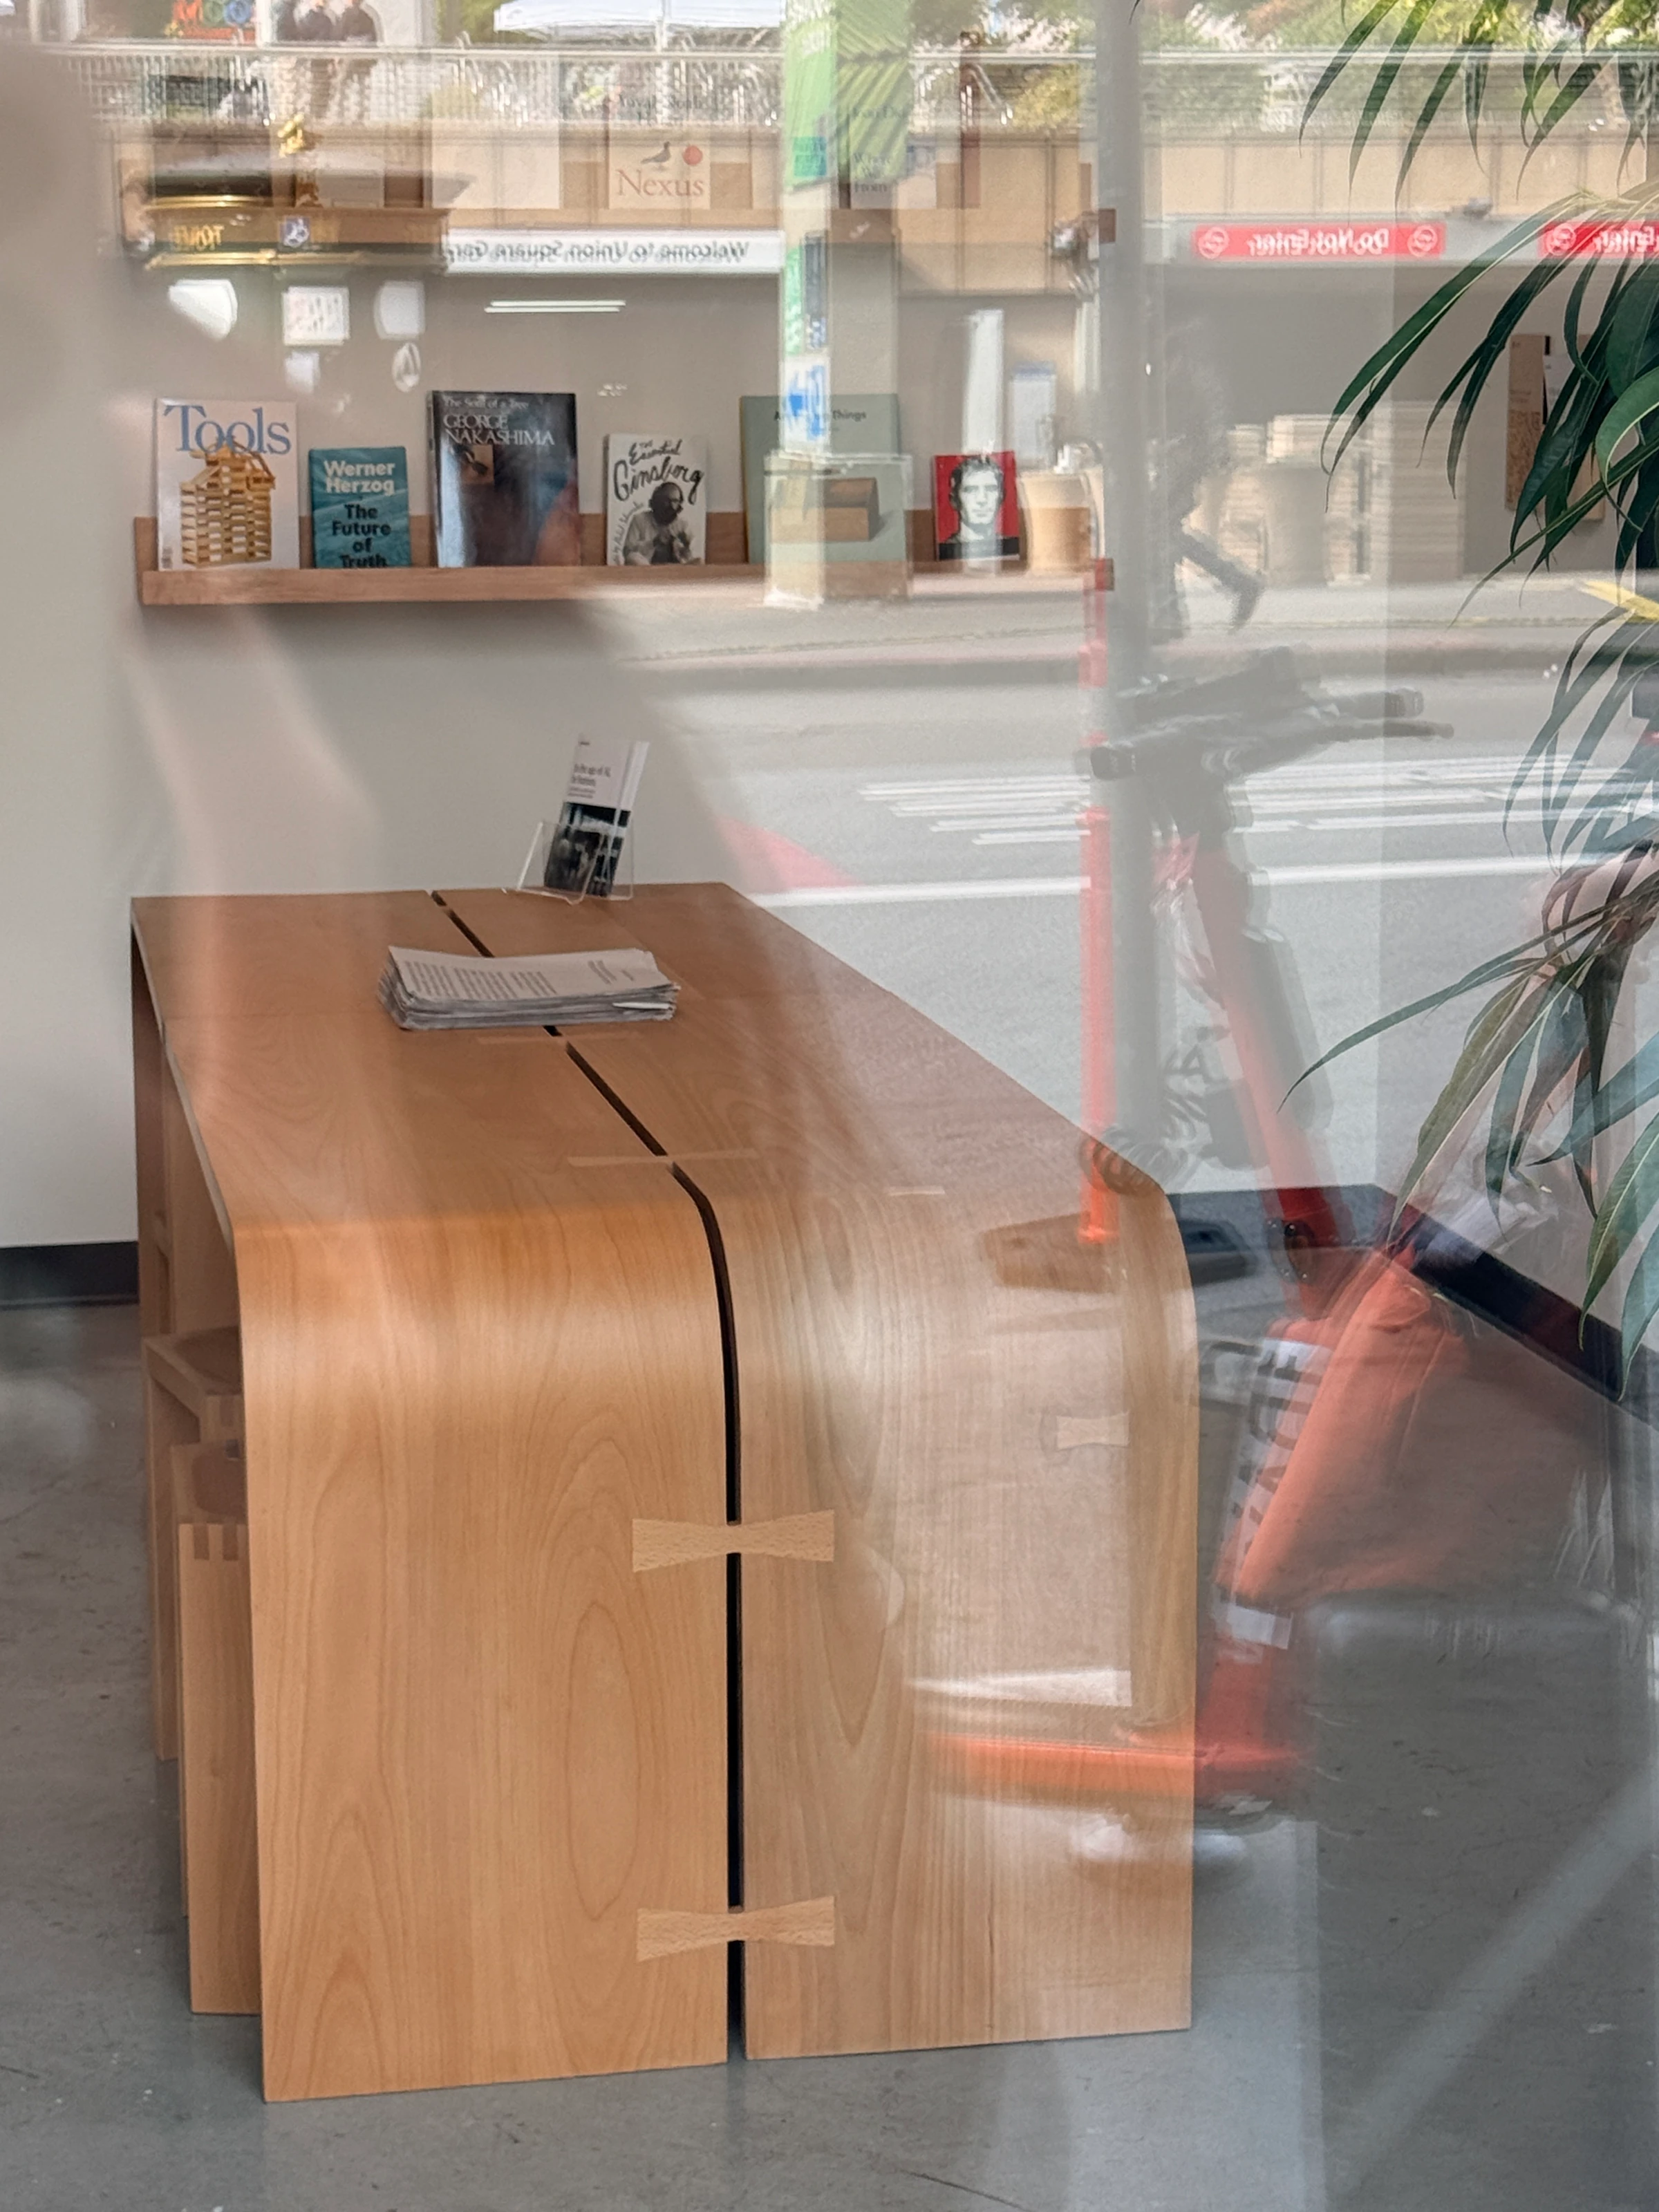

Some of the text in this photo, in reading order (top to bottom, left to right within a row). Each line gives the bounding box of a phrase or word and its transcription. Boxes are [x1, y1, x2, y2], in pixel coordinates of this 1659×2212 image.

[616, 169, 704, 198] Nexus
[163, 405, 292, 455] Tools
[443, 415, 508, 429] GEORGE
[445, 428, 555, 446] NAKASHIMA
[324, 460, 396, 477] Werner
[326, 477, 395, 497] Herzog
[344, 503, 378, 519] The
[332, 521, 392, 536] Future
[353, 538, 373, 552] of
[339, 555, 388, 568] Truth
